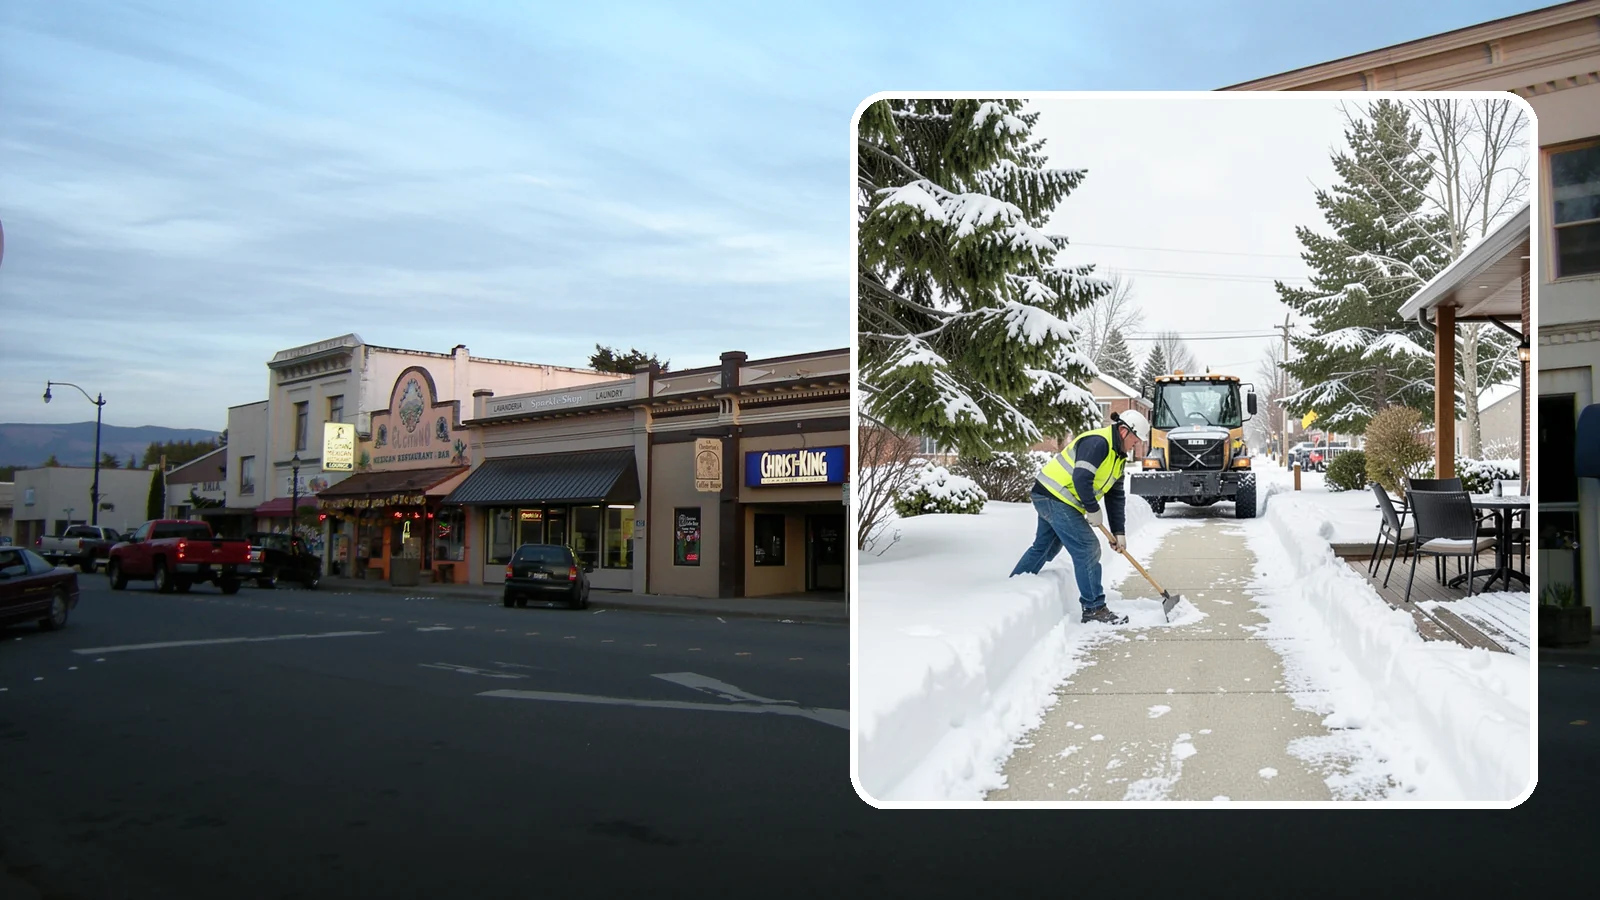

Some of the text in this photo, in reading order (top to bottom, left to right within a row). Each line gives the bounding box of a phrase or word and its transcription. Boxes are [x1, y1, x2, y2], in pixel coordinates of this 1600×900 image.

[562, 394, 582, 406] Shop
[595, 388, 624, 400] LAUNDRY
[493, 402, 522, 413] LAVANDERIA
[373, 454, 396, 464] MEXICAN
[397, 451, 434, 463] RESTAURANT
[437, 450, 450, 459] BAR
[760, 450, 828, 478] CHRIST KING
